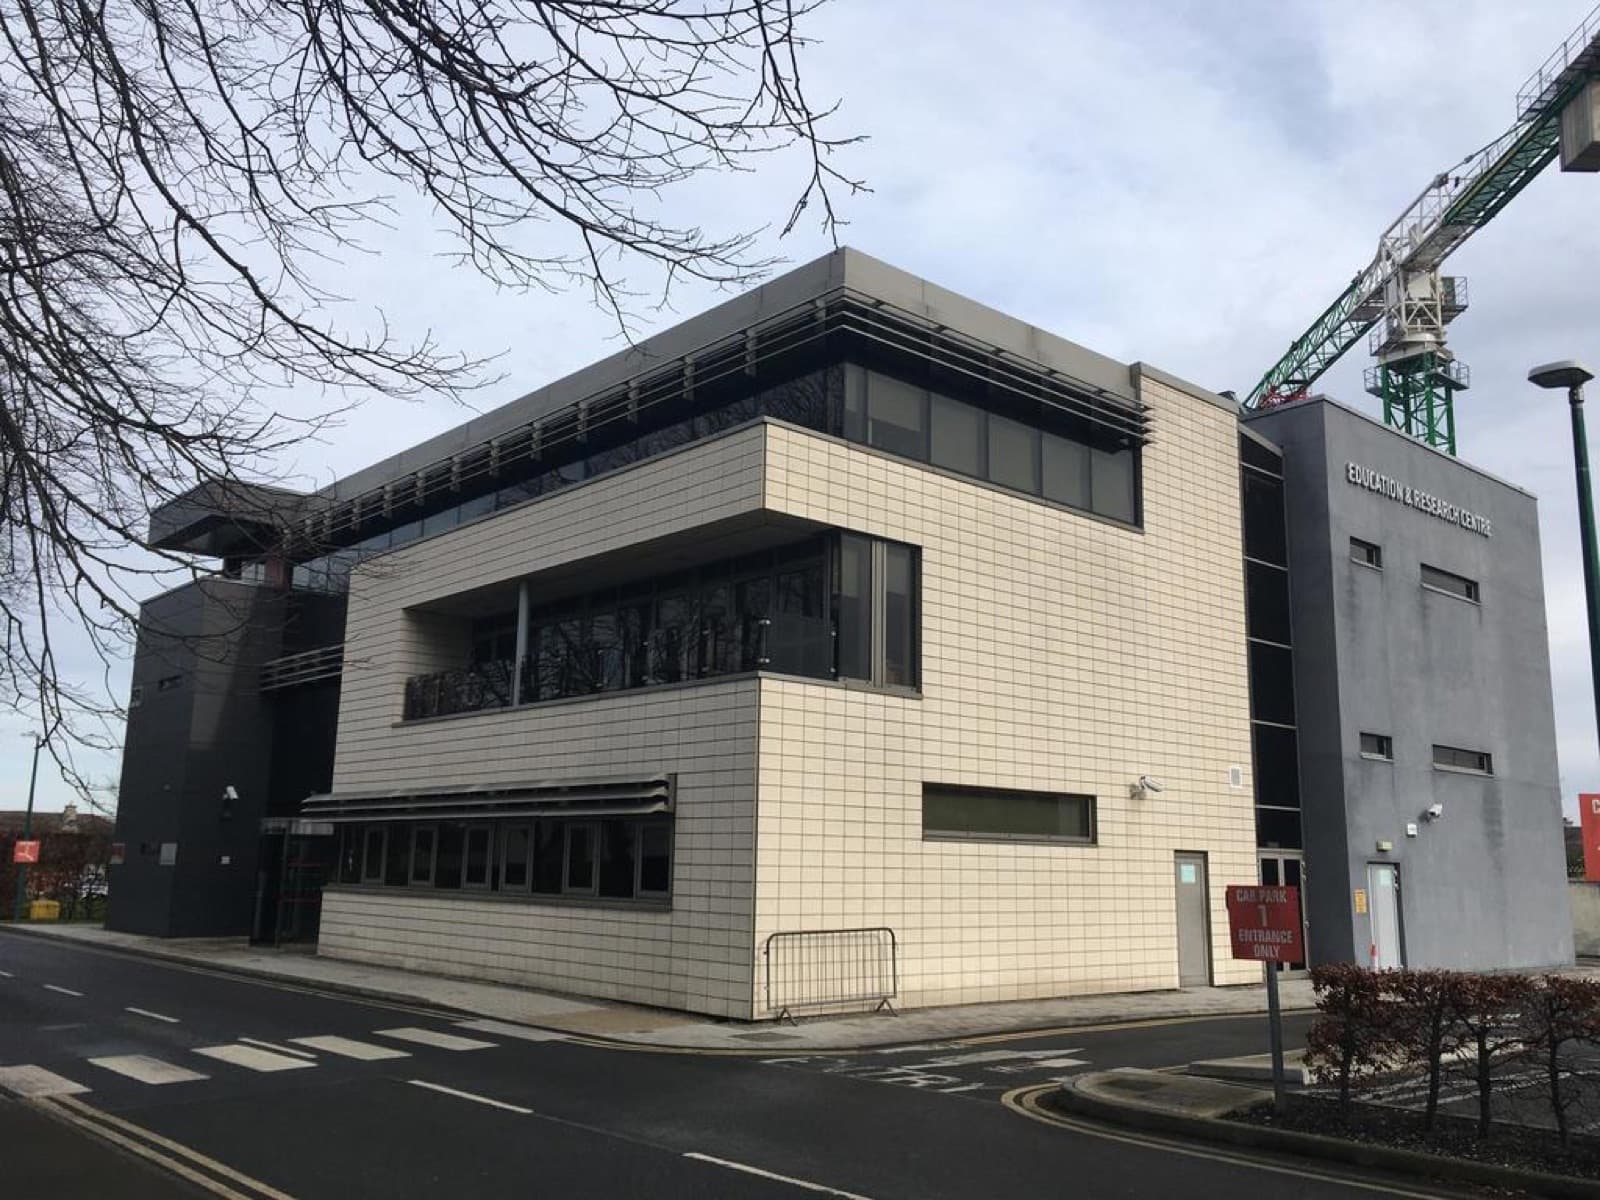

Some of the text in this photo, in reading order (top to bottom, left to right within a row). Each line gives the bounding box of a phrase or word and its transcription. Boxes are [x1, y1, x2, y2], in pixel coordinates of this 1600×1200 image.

[1348, 463, 1492, 537] EDUCATION & RESEARCH CENTRE
[1236, 888, 1287, 903] CAR PARK
[1257, 904, 1268, 927] 1
[1238, 928, 1293, 944] ENTRANCE
[1254, 943, 1280, 958] ONLY
